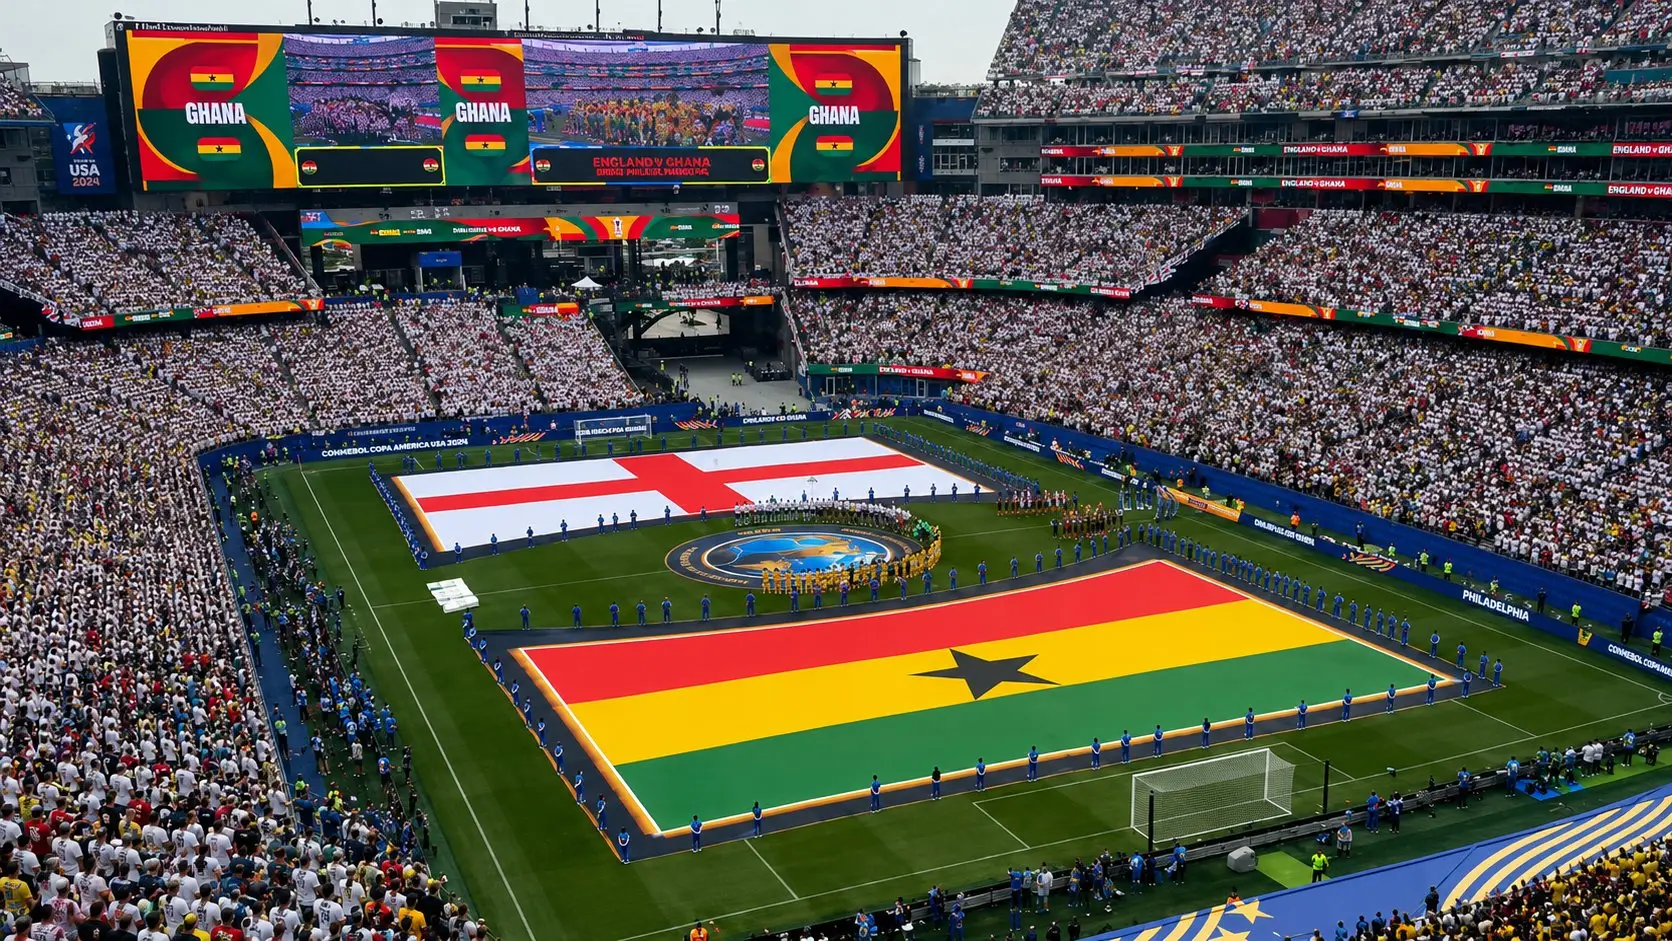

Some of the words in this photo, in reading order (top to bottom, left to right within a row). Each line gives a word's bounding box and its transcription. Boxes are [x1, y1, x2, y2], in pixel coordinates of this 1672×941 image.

[185, 102, 247, 125] GHANA
[455, 102, 512, 124] GHANA
[808, 105, 860, 126] GHANA
[1612, 145, 1652, 154] ENGLAND
[593, 157, 653, 167] ENGLAND
[69, 164, 100, 176] USA
[72, 177, 100, 187] 2024
[1607, 185, 1647, 195] ENGLAND
[370, 445, 393, 453] COPA
[393, 442, 430, 451] AMERICA
[1462, 589, 1530, 622] PHILADELPHIA
